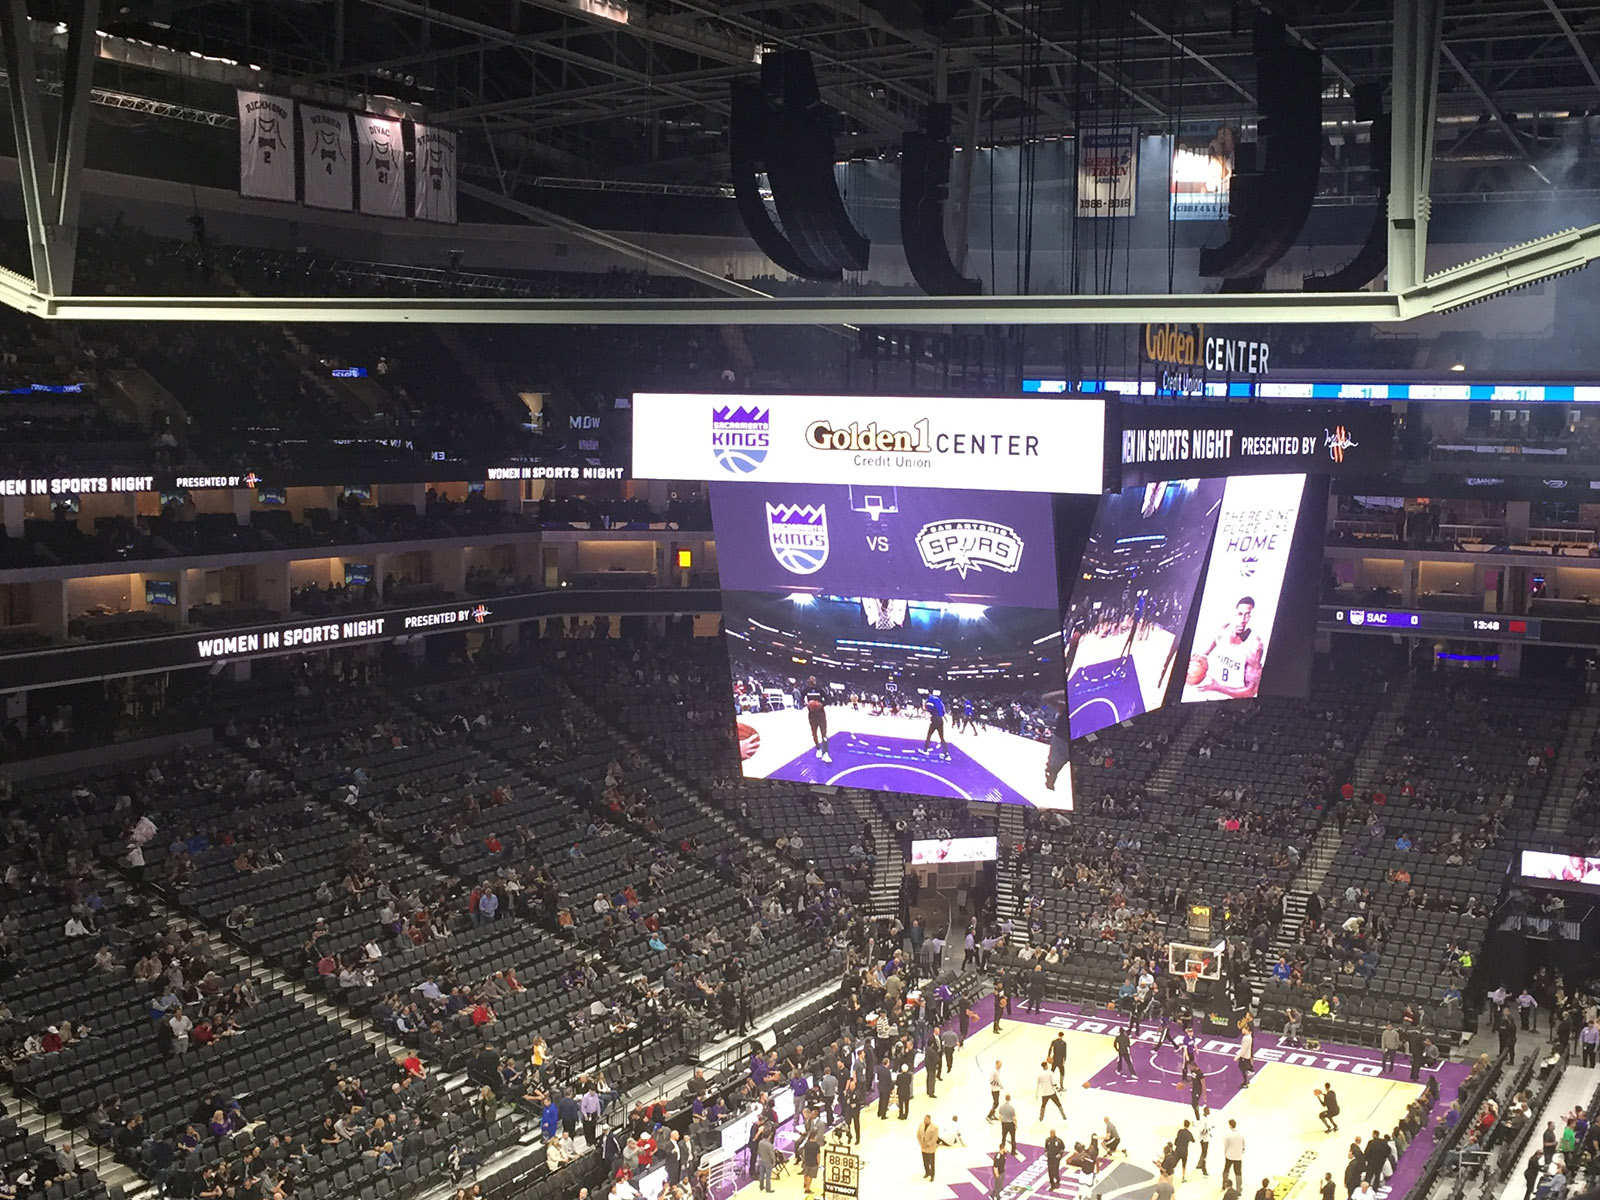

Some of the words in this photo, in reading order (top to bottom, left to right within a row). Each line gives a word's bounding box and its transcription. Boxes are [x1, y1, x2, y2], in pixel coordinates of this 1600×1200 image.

[369, 126, 390, 137] DIVAC
[263, 151, 271, 164] 2
[326, 163, 332, 175] 4
[378, 171, 388, 184] 21
[1205, 337, 1269, 374] CENTER
[712, 432, 769, 446] KINGS
[936, 433, 1039, 456] CENTER
[1136, 429, 1146, 463] IN
[1148, 429, 1189, 461] SPORTS
[1192, 429, 1233, 459] NIGHT
[1241, 437, 1299, 455] PRESENTED
[1301, 436, 1317, 455] BY
[853, 454, 890, 467] Credit
[895, 456, 931, 468] Union
[487, 468, 520, 479] WOMEN
[521, 467, 531, 479] IN
[532, 467, 579, 479] SPORTS
[583, 467, 624, 479] NIGHT
[30, 479, 47, 495] IN
[51, 477, 108, 494] SPORTS
[111, 476, 153, 492] NIGHT
[176, 476, 227, 488] PRESENTED
[228, 476, 240, 486] BY
[929, 524, 952, 534] SAN
[956, 523, 1008, 536] ANTONIO
[772, 533, 825, 546] KINGS
[866, 535, 889, 552] VS
[1226, 534, 1279, 552] HOME
[928, 536, 1011, 558] SPURS
[1336, 611, 1344, 621] 0
[1366, 613, 1387, 623] SAC
[1410, 615, 1419, 625] 0
[198, 634, 259, 657] WOMEN
[263, 632, 279, 648] IN
[283, 624, 340, 647] SPORTS
[343, 618, 385, 639] NIGHT
[404, 612, 456, 629] PRESENTED
[457, 609, 470, 622] BY
[1221, 668, 1229, 682] 8
